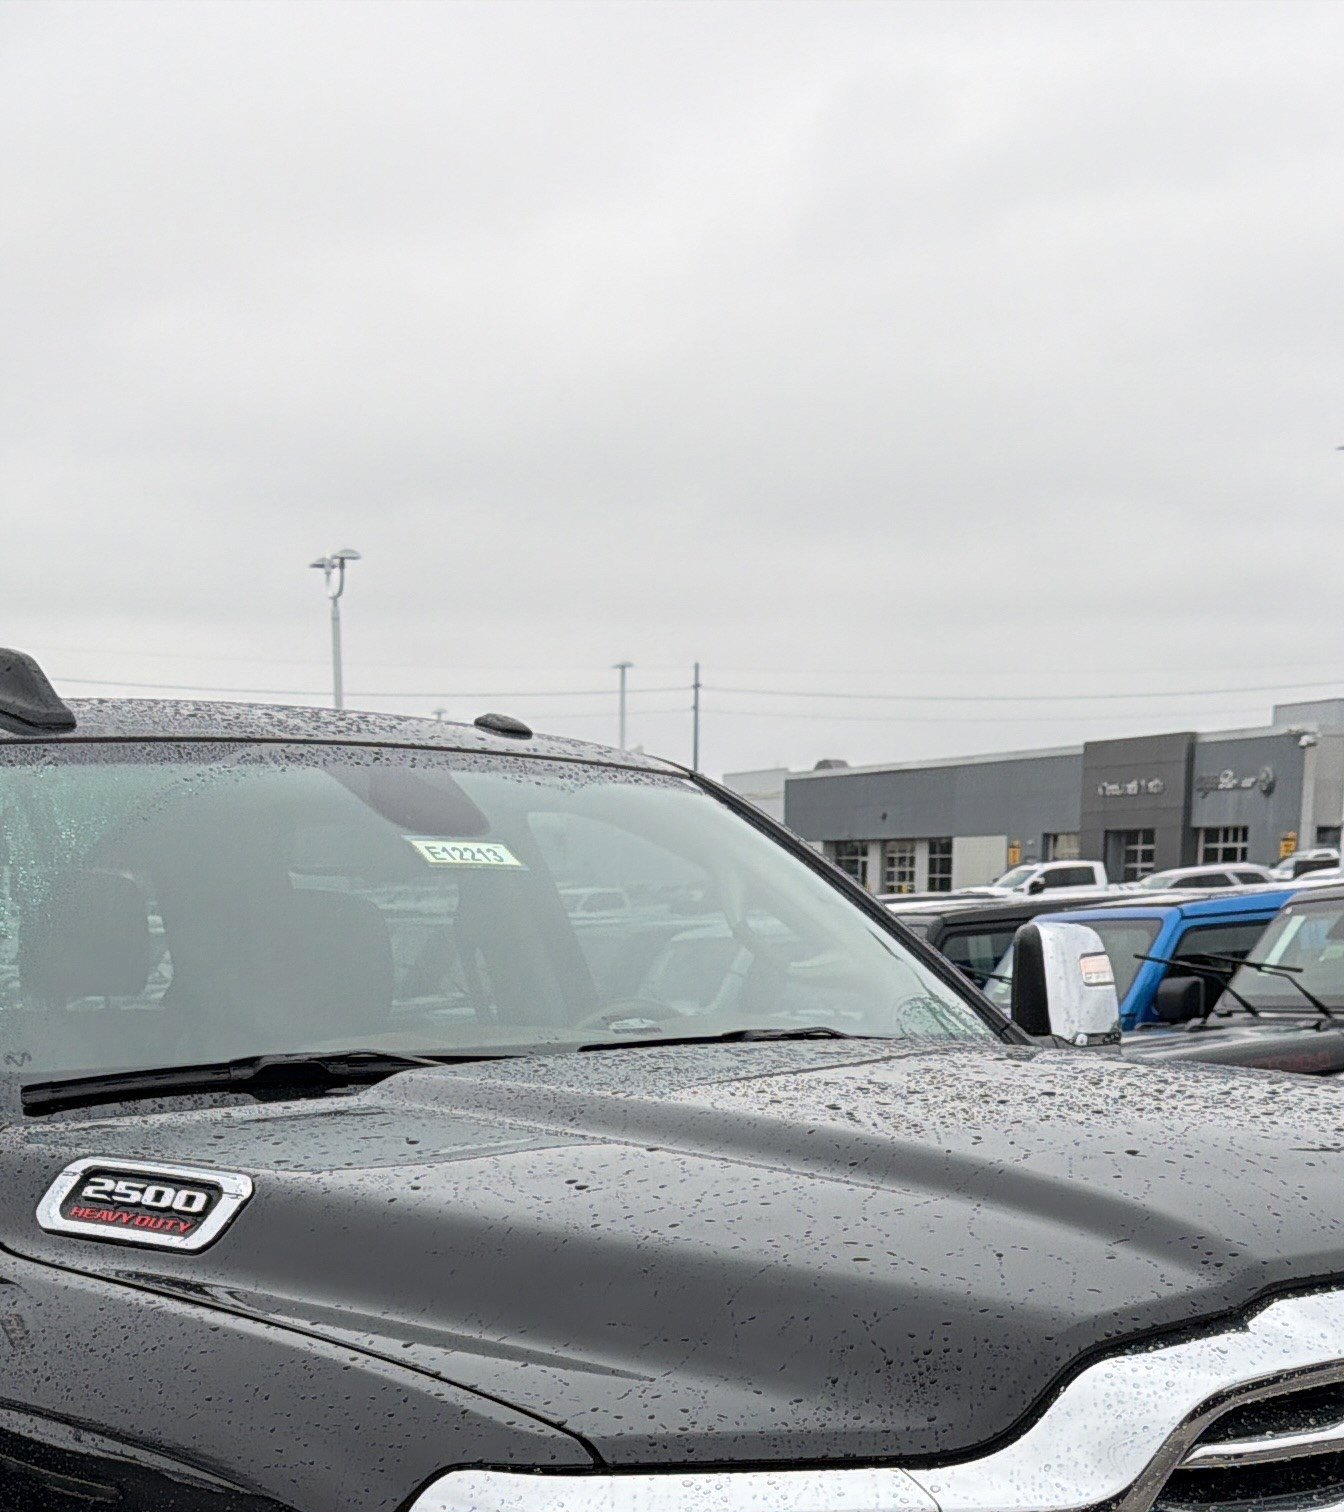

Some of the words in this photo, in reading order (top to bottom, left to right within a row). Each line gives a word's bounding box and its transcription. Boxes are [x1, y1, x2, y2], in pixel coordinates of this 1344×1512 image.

[424, 845, 505, 863] E12213
[81, 1177, 209, 1212] 2500
[70, 1206, 136, 1225] HEAVY
[136, 1215, 195, 1233] DUTY
